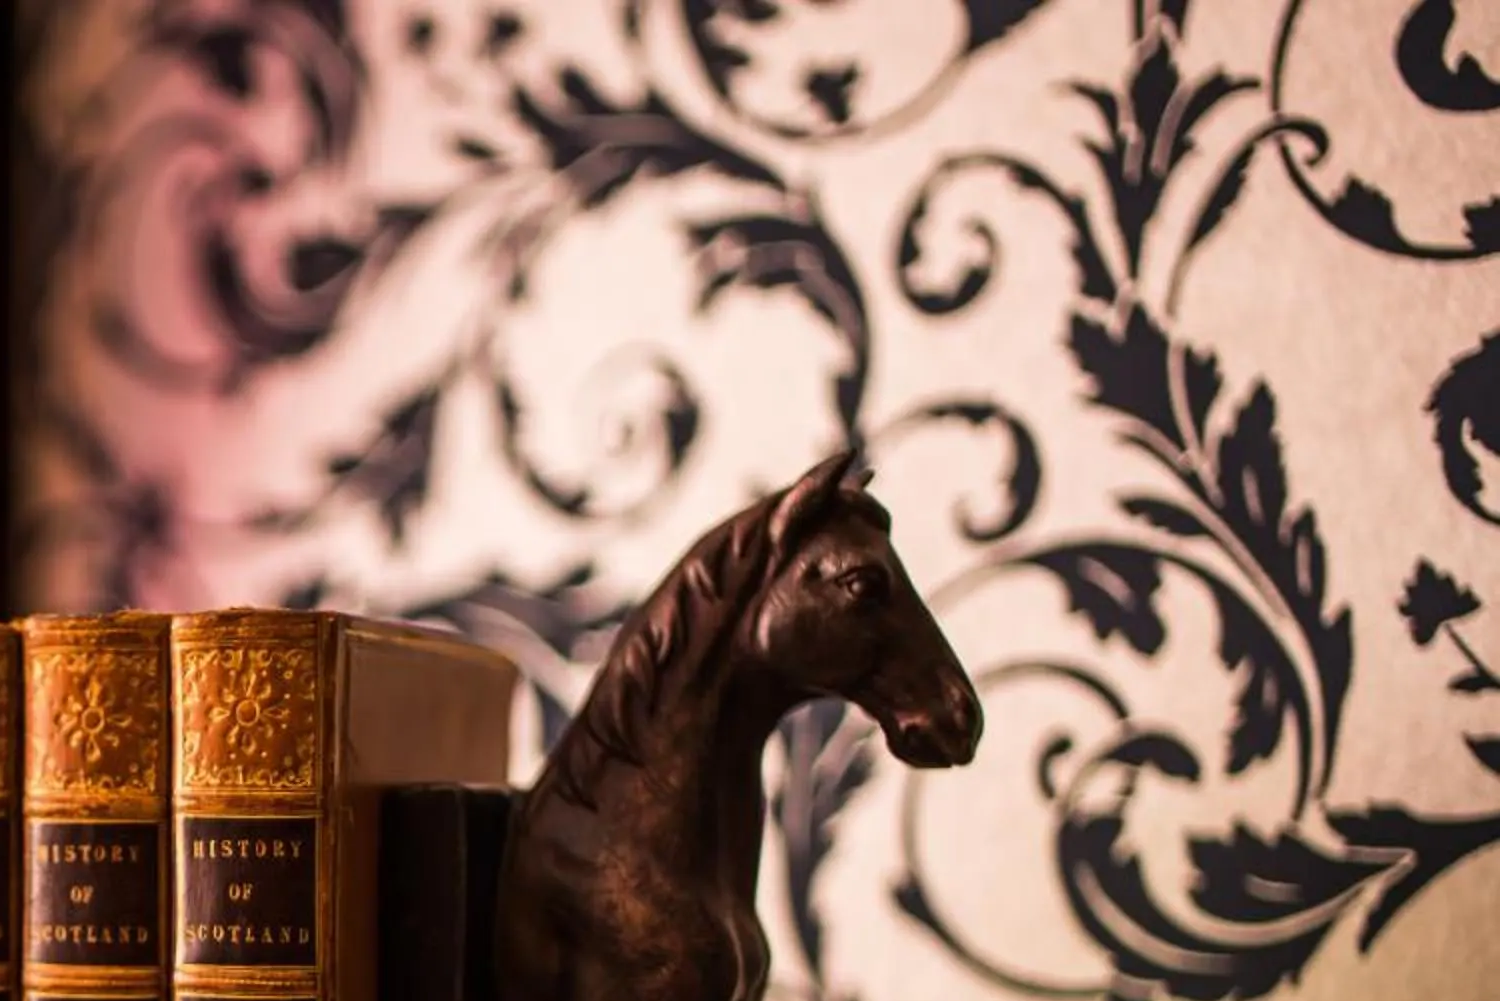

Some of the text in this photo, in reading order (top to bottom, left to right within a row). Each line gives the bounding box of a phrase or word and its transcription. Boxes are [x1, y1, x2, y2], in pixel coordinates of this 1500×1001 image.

[193, 839, 302, 859] HISTORY
[69, 885, 95, 903] OF
[228, 883, 254, 900] OF
[184, 924, 309, 943] SCOTLAND
